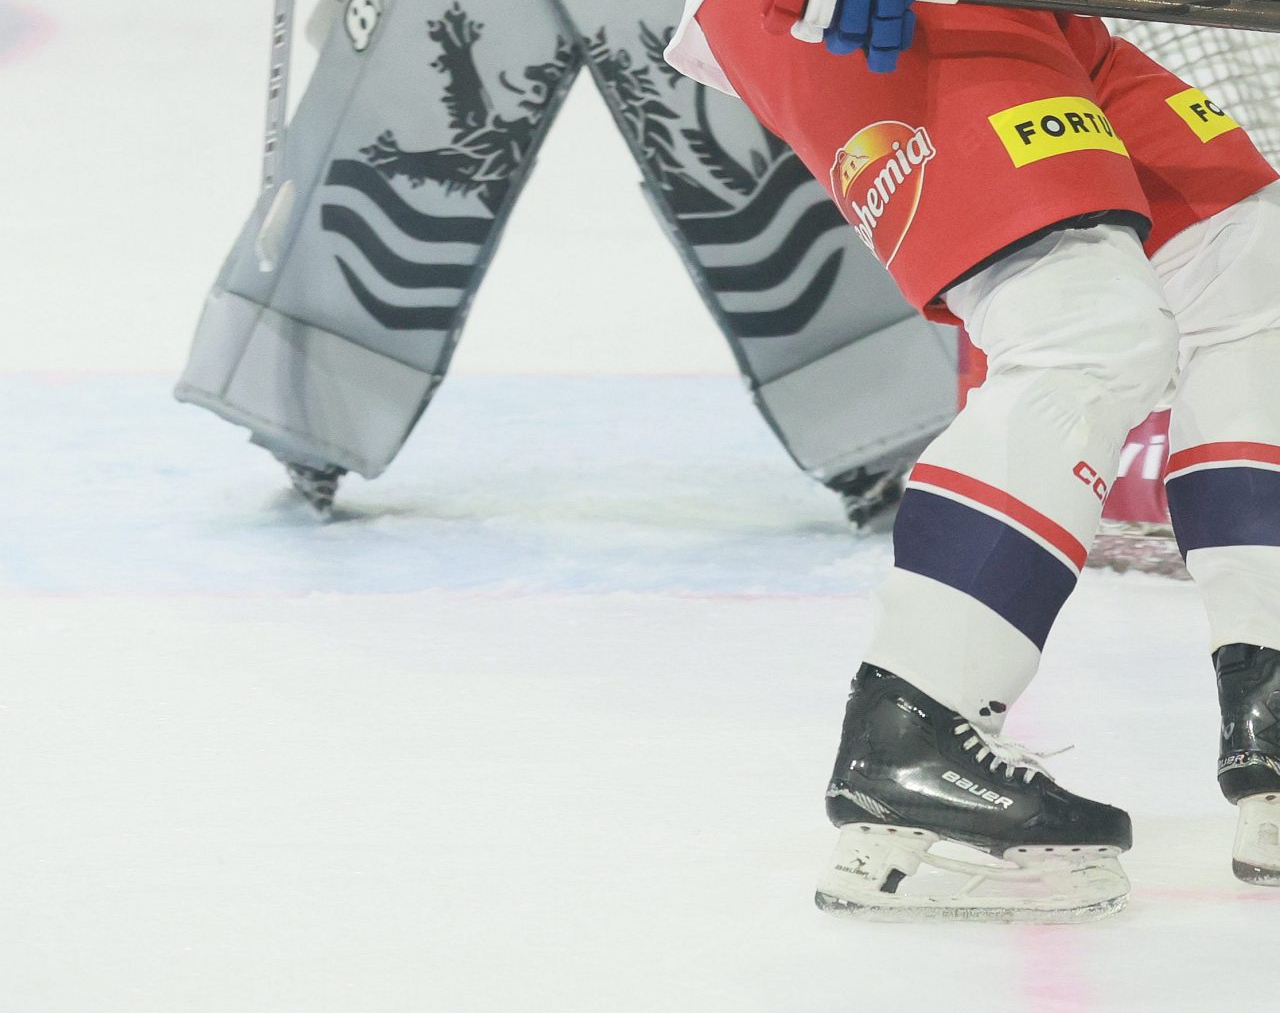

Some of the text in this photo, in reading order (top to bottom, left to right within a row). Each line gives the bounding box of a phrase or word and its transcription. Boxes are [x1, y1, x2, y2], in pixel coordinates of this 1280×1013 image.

[1014, 111, 1121, 145] FORTU
[1072, 459, 1107, 500] CC
[941, 770, 1014, 809] BAUER
